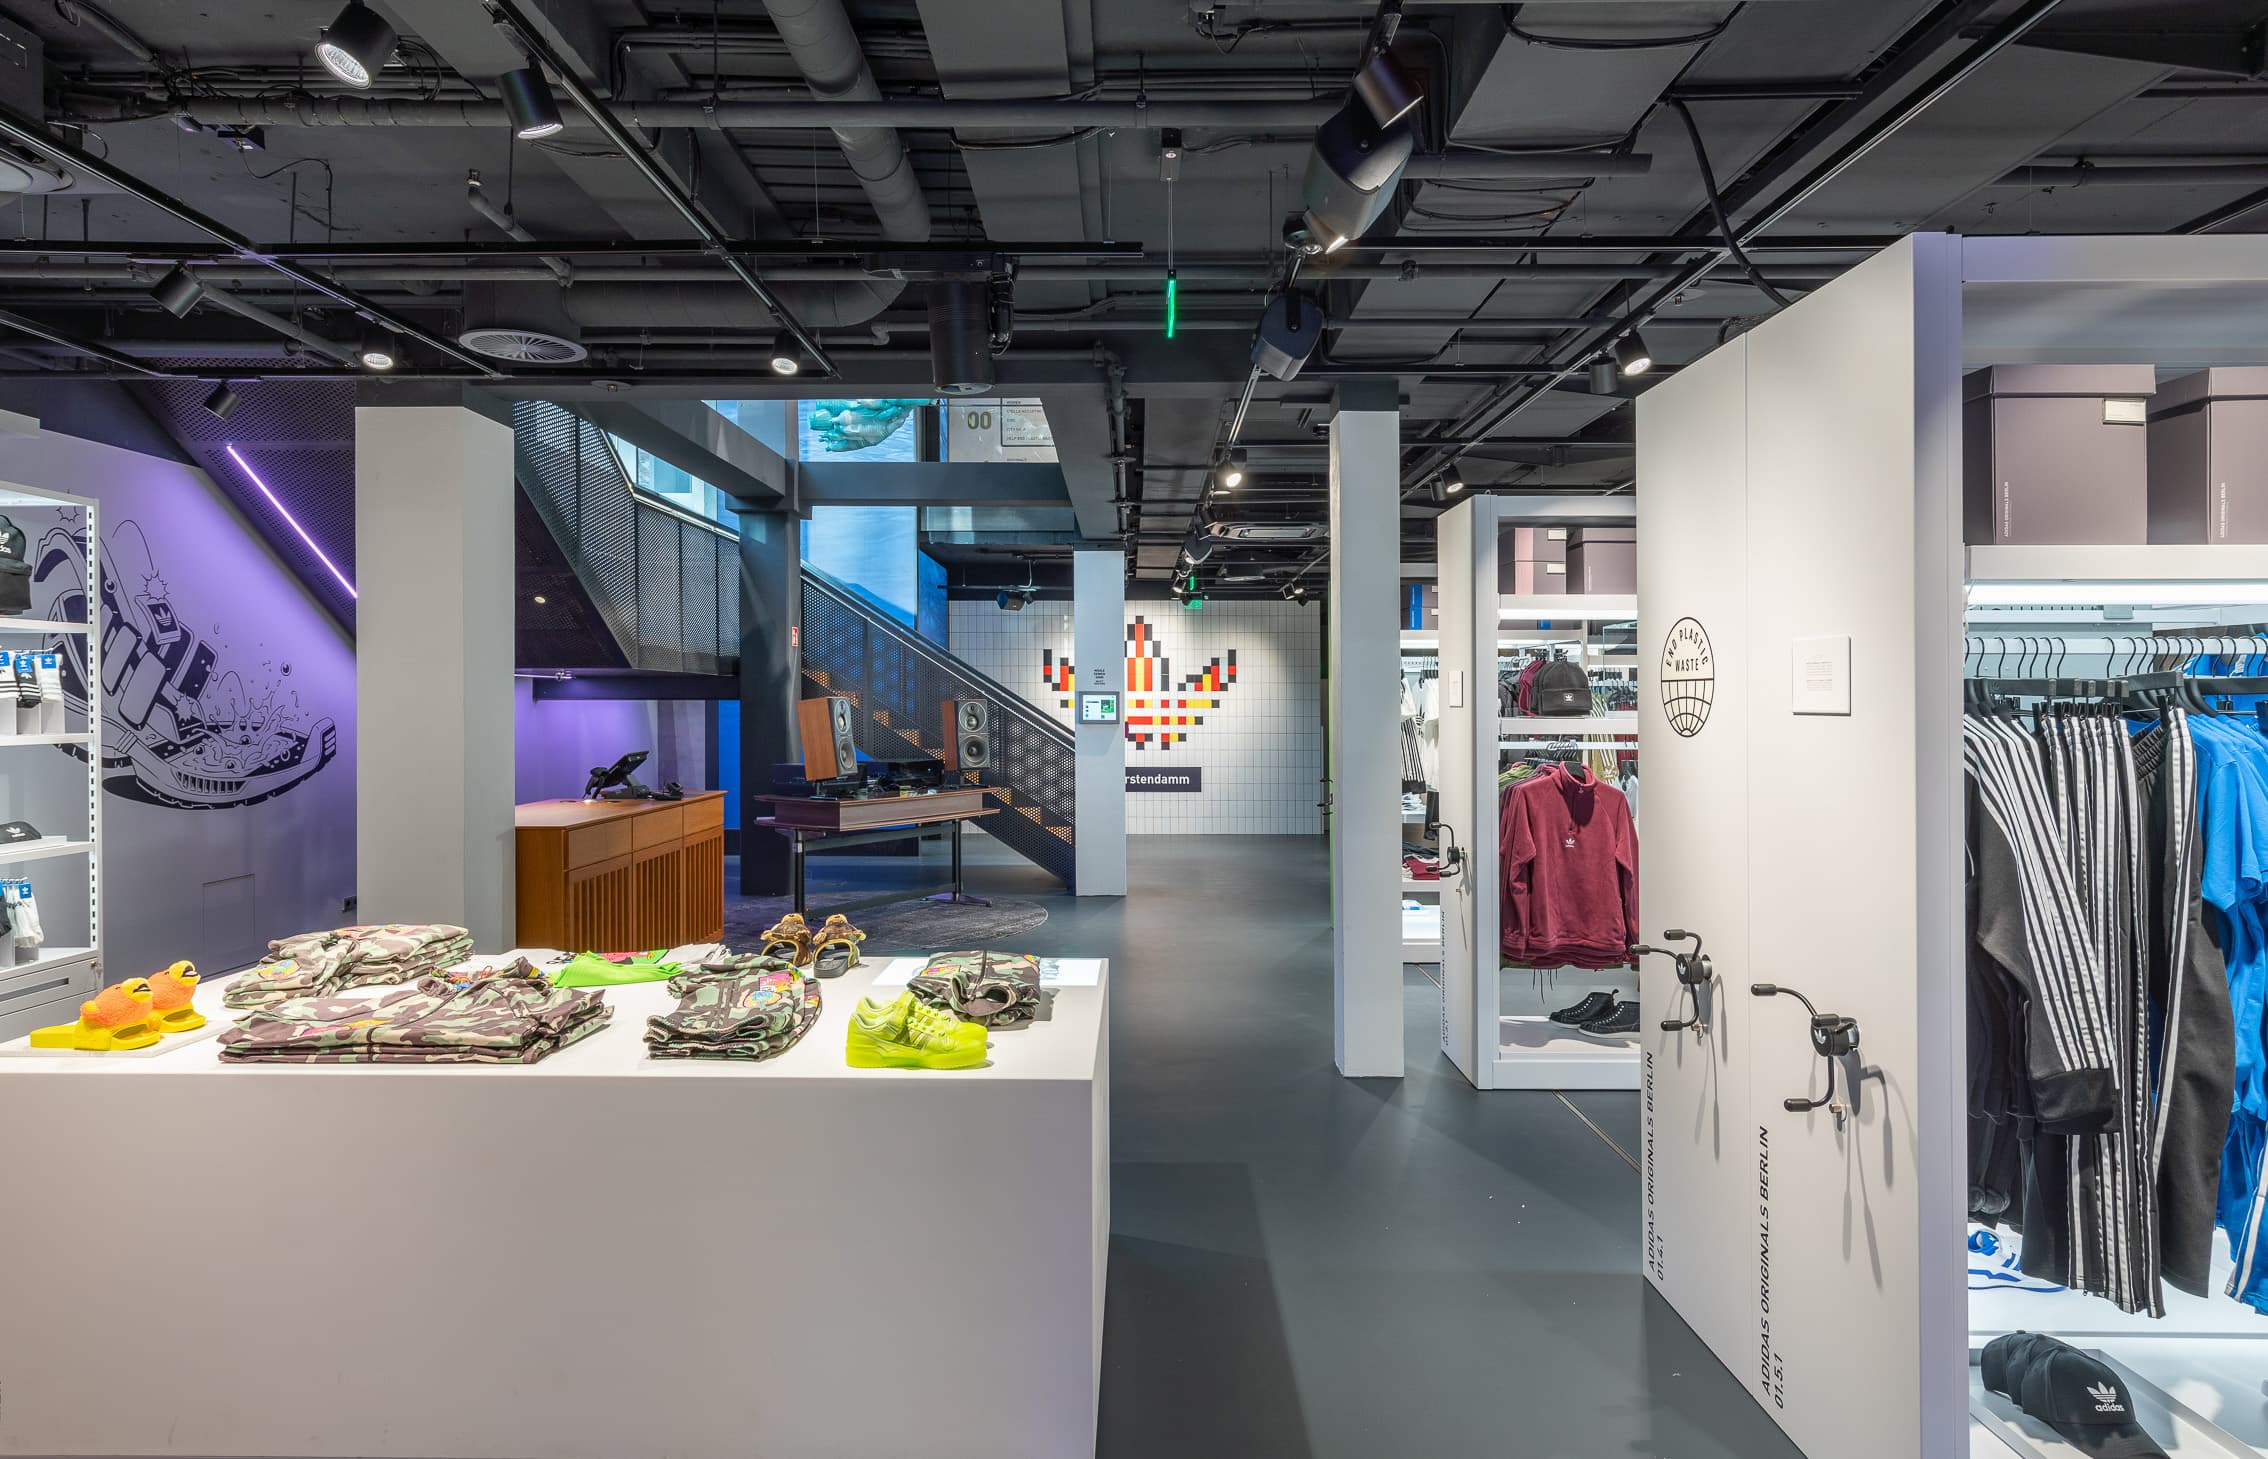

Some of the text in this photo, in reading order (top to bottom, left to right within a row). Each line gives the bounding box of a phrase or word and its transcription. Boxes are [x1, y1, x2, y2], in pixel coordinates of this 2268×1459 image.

[967, 411, 992, 430] 00
[1665, 627, 1708, 667] END PLASTIC
[1675, 658, 1699, 672] WASTE
[1125, 773, 1190, 785] rstendamm
[1646, 1051, 1655, 1273] ADIDAS ORIGINALS BERLIN
[1656, 1234, 1664, 1282] 01.4.1
[1759, 1125, 1771, 1397] ADIDAS ORIGINALS BERLIN
[1773, 1352, 1784, 1410] 01.5.1
[2095, 1402, 2125, 1412] adidas
